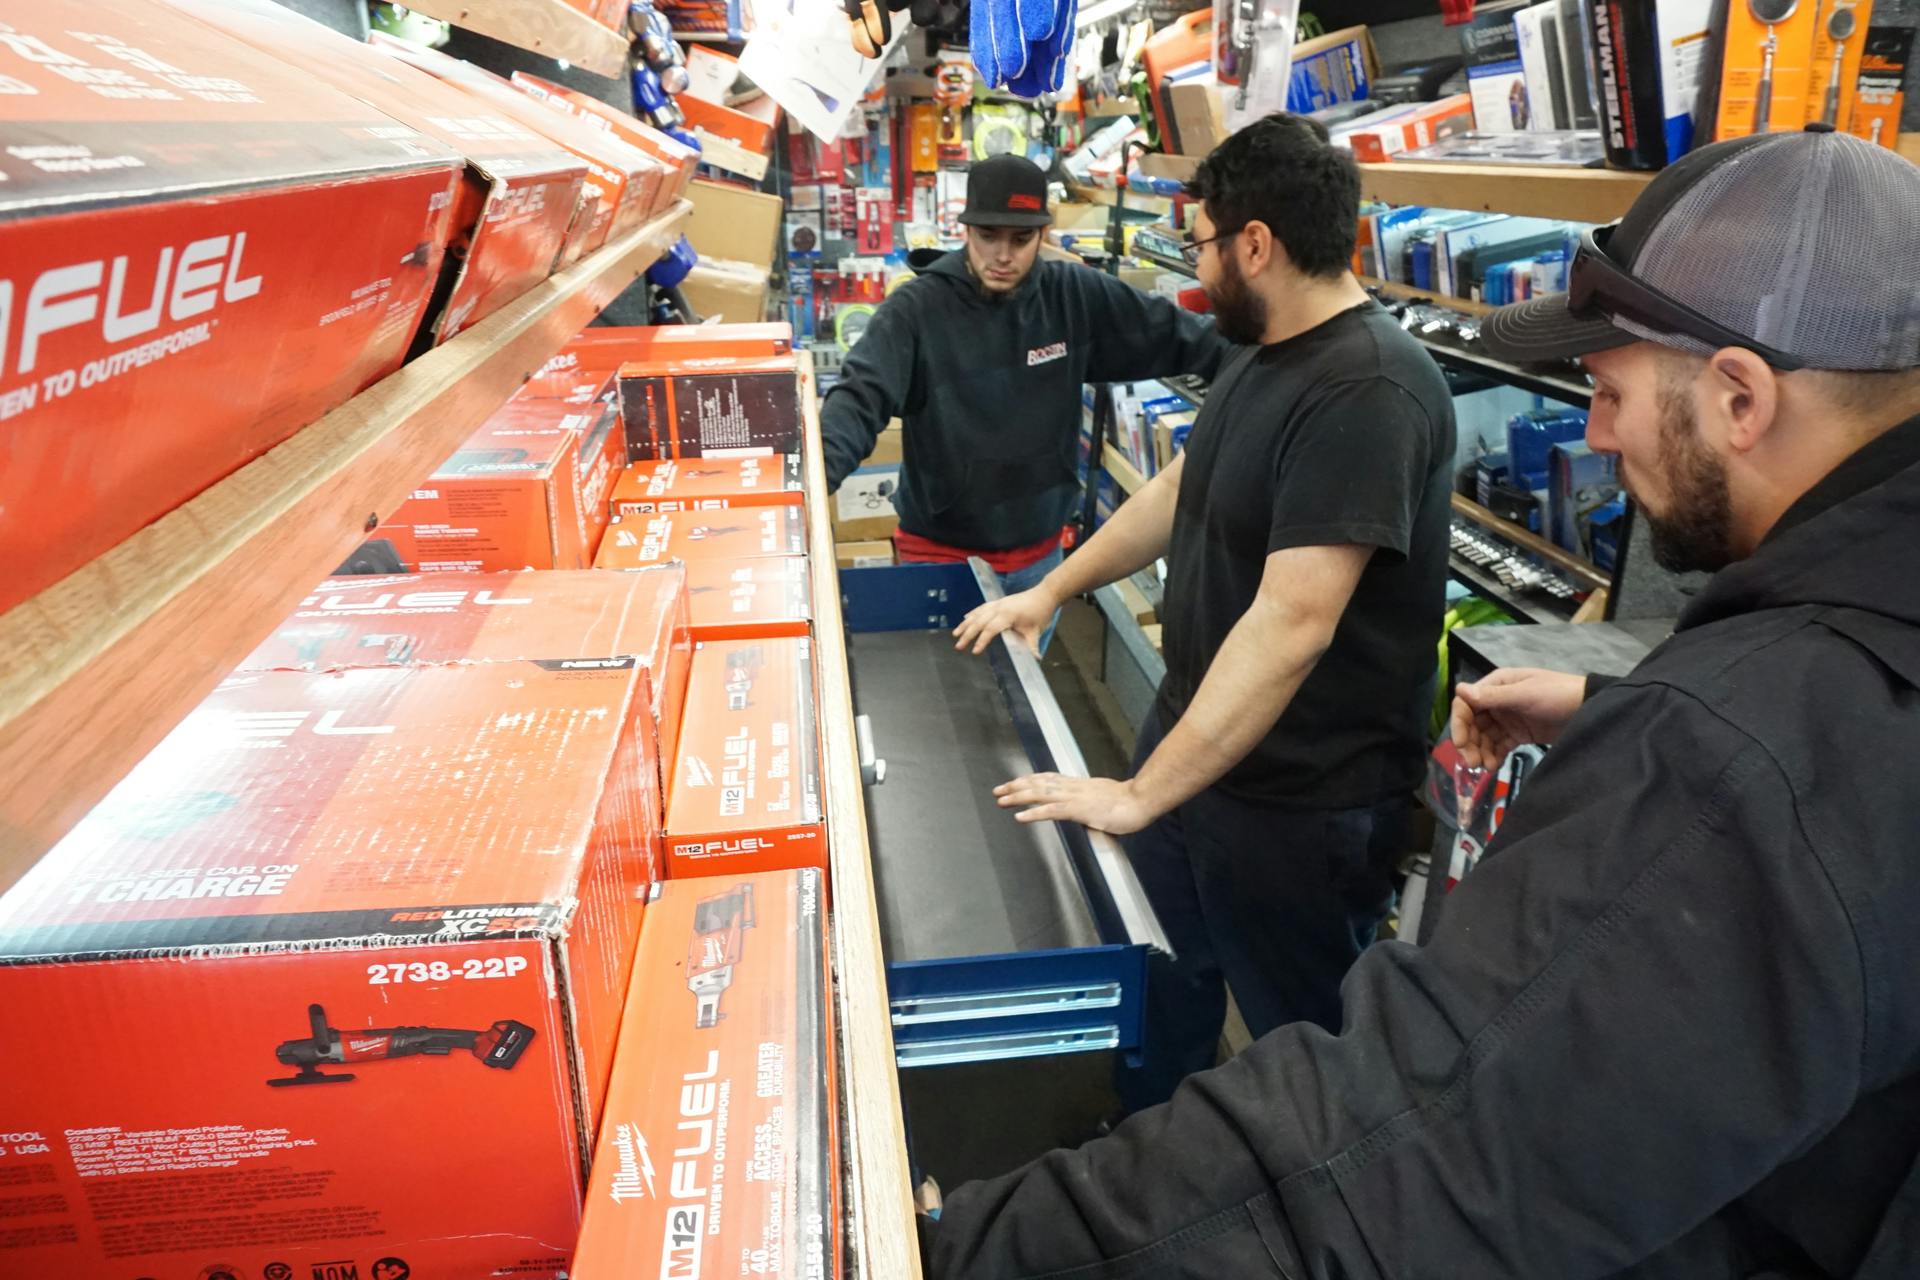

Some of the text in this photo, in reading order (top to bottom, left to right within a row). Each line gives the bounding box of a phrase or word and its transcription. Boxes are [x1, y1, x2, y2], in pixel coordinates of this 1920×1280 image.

[1594, 4, 1625, 149] STEELMAN
[17, 231, 263, 375] FUEL
[43, 369, 76, 402] TO
[722, 727, 749, 786] FUEL
[706, 838, 775, 854] FUEL
[206, 865, 256, 876] CAR
[261, 864, 300, 874] ON
[98, 873, 292, 902] CHARGE
[389, 907, 543, 922] REDLITHIUM
[367, 956, 528, 984] 2738-22P
[756, 1042, 774, 1098] GREATER
[773, 1044, 785, 1096] DURABILITY
[64, 1127, 121, 1136] Contains:
[124, 1130, 166, 1138] Variable
[167, 1127, 201, 1136] Speed
[217, 1131, 254, 1139] Battery
[255, 1128, 290, 1136] Packs,
[670, 1049, 720, 1199] FUEL
[773, 1106, 784, 1145] SPACES
[14, 1143, 51, 1155] USA
[71, 1148, 114, 1157] Backing
[179, 1140, 217, 1149] Cutting
[254, 1135, 286, 1143] Yellow
[76, 1162, 114, 1170] Screen
[233, 1150, 270, 1158] Handle
[105, 1152, 152, 1161] Polishing
[189, 1147, 217, 1155] Black
[249, 1141, 293, 1150] Finishing
[707, 1078, 731, 1236] DRIVEN TO OUTPERFORM.
[754, 1124, 773, 1181] ACCESS
[79, 1169, 102, 1177] with
[117, 1166, 145, 1174] Bolts
[167, 1162, 197, 1170] Rapid
[198, 1160, 239, 1168] Charger
[610, 1122, 643, 1206] Milwaukee
[668, 1208, 698, 1280] M12
[769, 1242, 782, 1273] MAX
[741, 1248, 751, 1275] UP TO
[751, 1249, 770, 1274] 40
